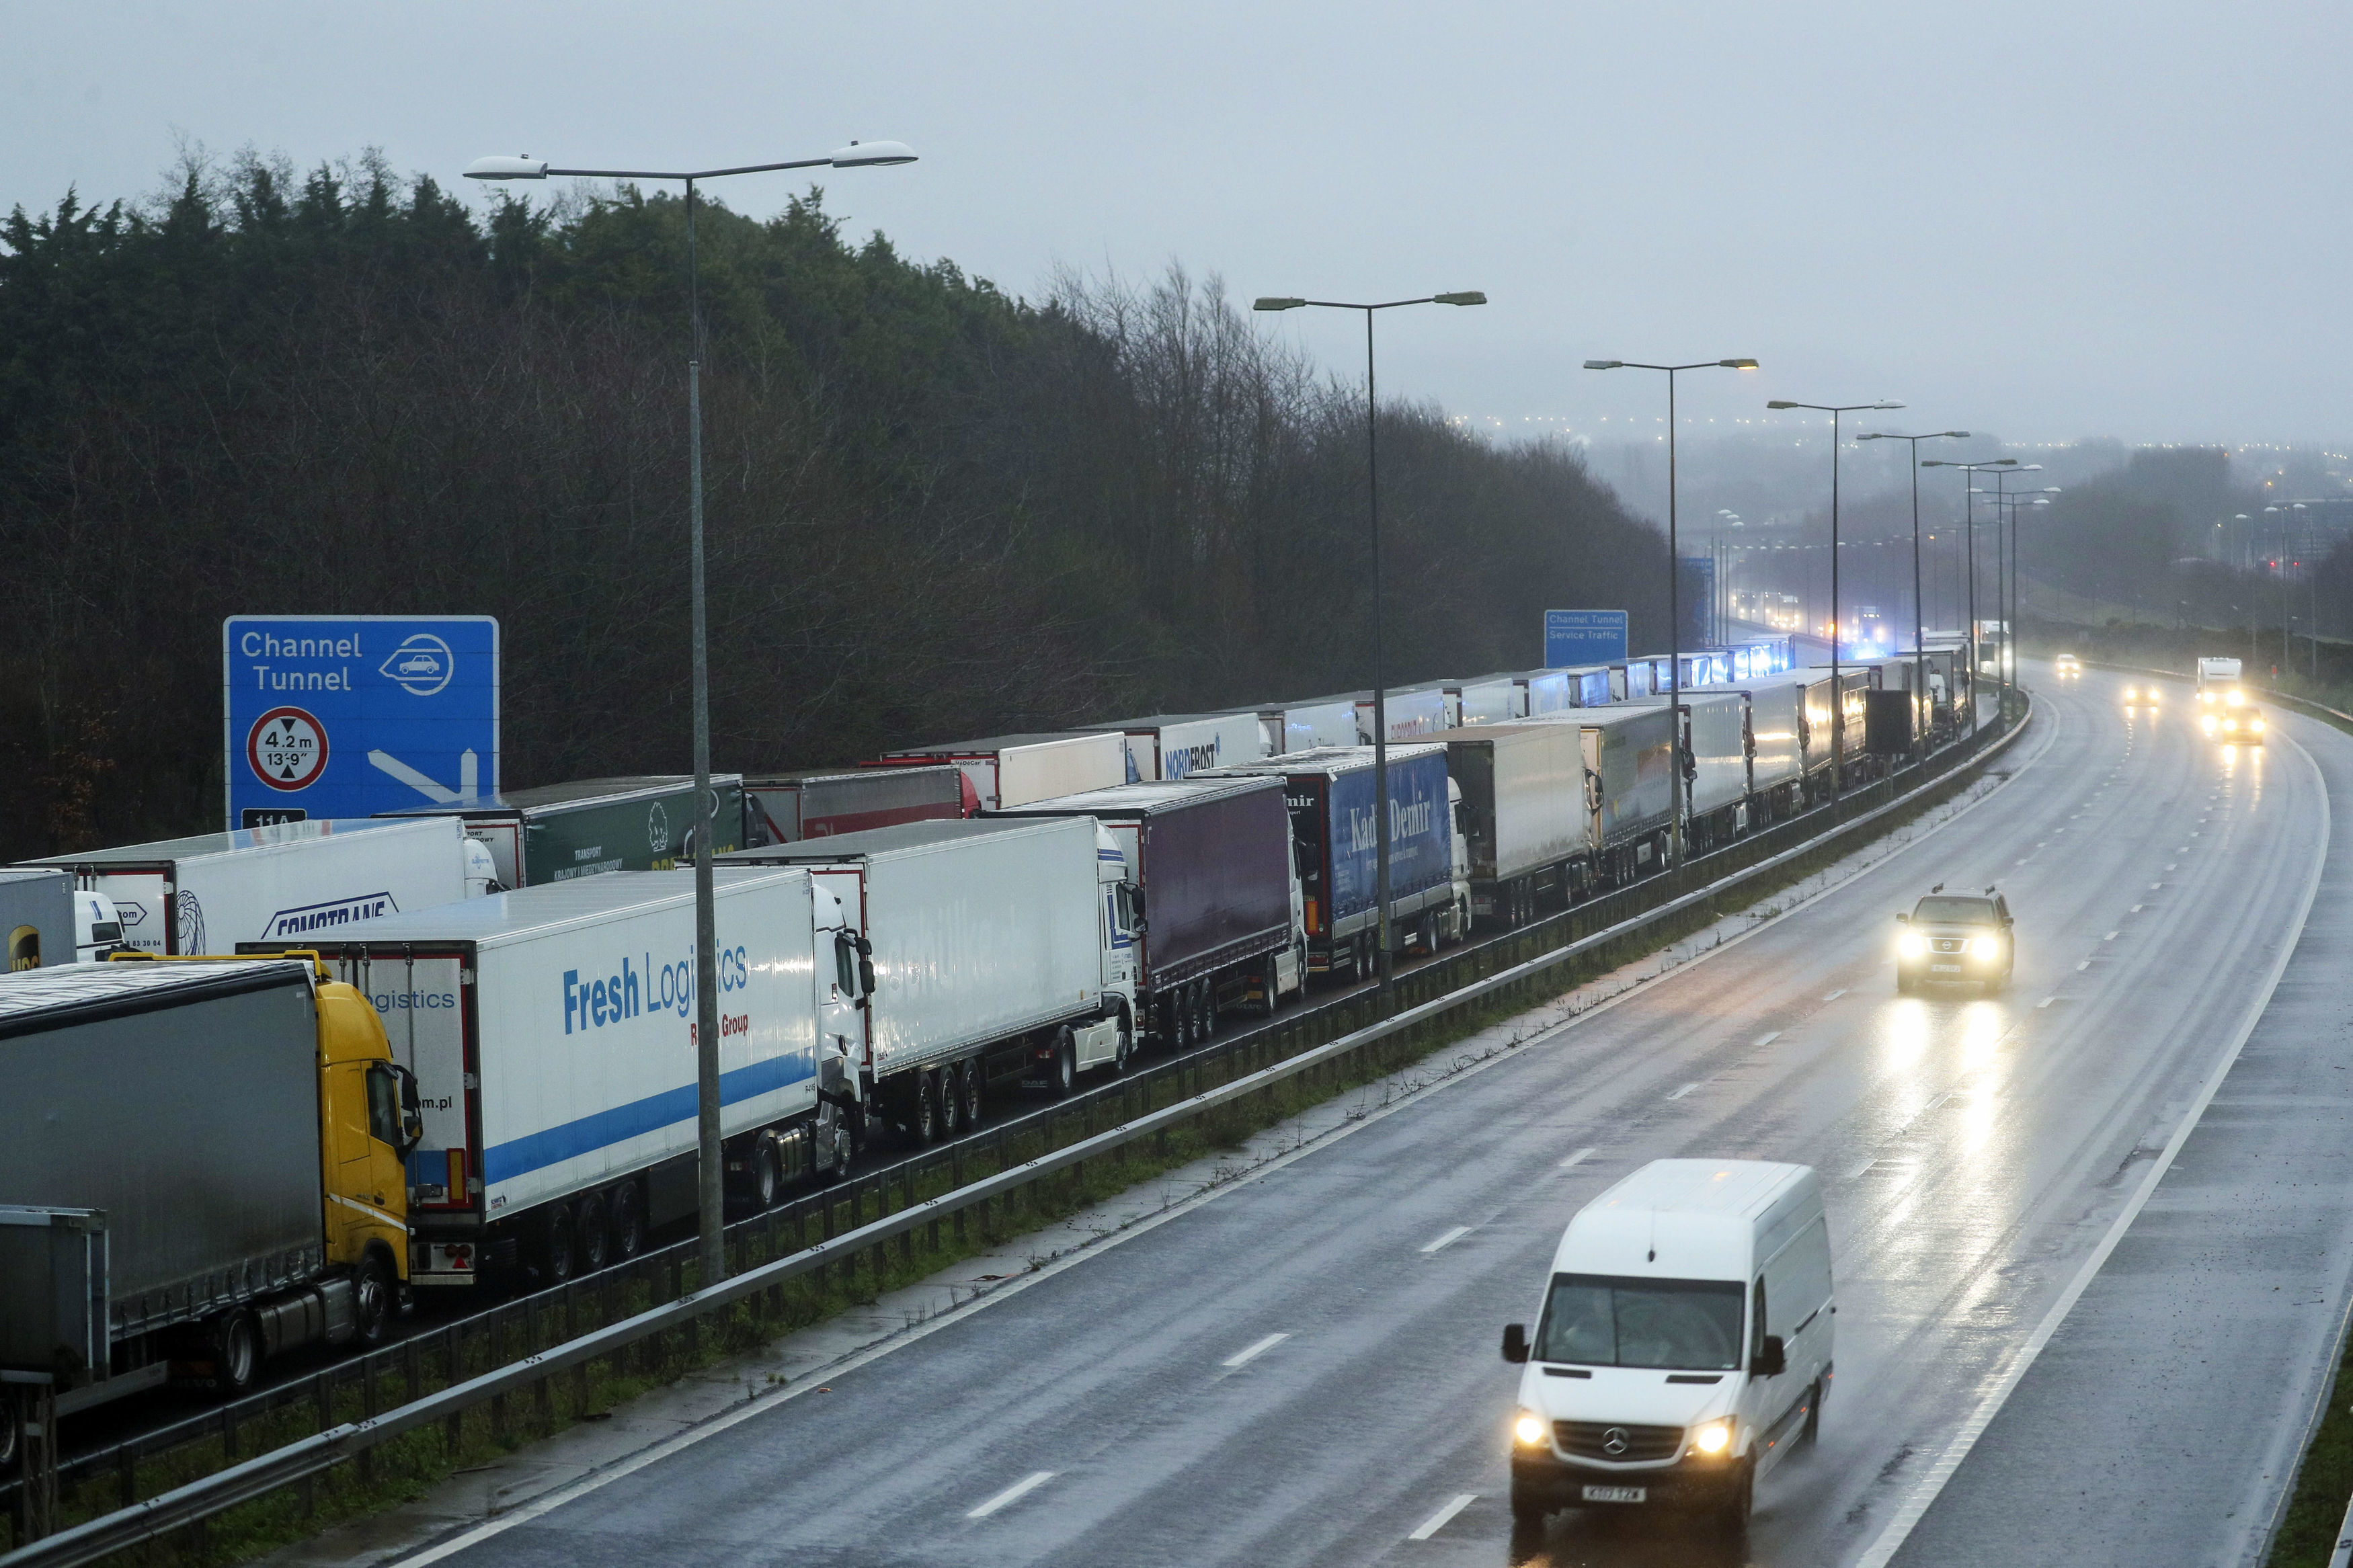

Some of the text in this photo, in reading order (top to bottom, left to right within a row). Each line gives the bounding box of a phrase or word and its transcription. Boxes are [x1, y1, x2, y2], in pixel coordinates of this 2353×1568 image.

[1549, 614, 1624, 624] Channel Tunnel
[241, 632, 362, 657] Channel
[1550, 630, 1618, 639] Service Traffic
[253, 665, 351, 691] Tunnel
[265, 731, 312, 747] 4.2 m
[1165, 743, 1215, 780] NORDFROST
[1390, 790, 1431, 842] Demir
[575, 845, 602, 861] TRANSPORT
[554, 866, 577, 881] KRAJOWY
[563, 938, 747, 1035] Fresh Logiics
[364, 989, 455, 1013] ogistics
[721, 1014, 748, 1038] Group
